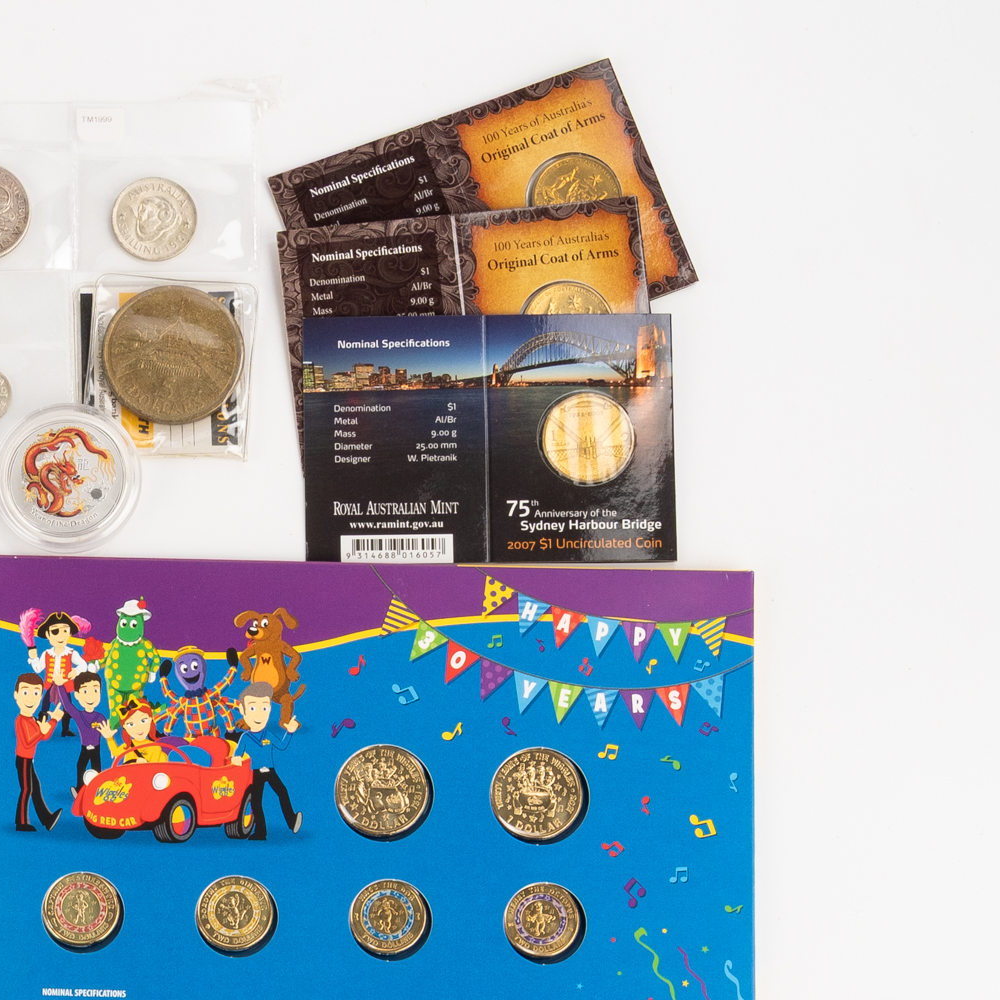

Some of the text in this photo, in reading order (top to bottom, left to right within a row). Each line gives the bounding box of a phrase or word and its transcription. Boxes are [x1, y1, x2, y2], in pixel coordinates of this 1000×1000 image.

[82, 115, 113, 123] TM1999
[482, 100, 593, 145] 100 Years of Australia's
[481, 113, 606, 164] Original Coat of Arms
[309, 155, 416, 198] Nominal Specifications
[418, 175, 428, 185] $1
[313, 197, 368, 222] Denomination
[487, 249, 619, 273] Original Coat of Arms
[337, 338, 451, 350] Nominal Specifications
[333, 404, 392, 413] Denomination
[447, 401, 457, 412] $1
[334, 442, 373, 451] Diameter
[415, 442, 439, 452] 25.00
[334, 455, 372, 465] Designer
[407, 453, 458, 462] W. Pietranik
[534, 509, 588, 519] Anniversary
[590, 509, 600, 517] of
[602, 508, 617, 517] the
[349, 519, 444, 530] www.ramint.gov.au
[520, 517, 662, 534] Sydney Harbour Bridge
[507, 536, 662, 552] 2007 $1 Uncirculated Coin
[402, 551, 441, 559] 016057
[522, 602, 681, 646] HAPPY
[86, 810, 138, 827] BIG RED CAR
[42, 987, 127, 999] NOMINAL SPECIFICATIONS
